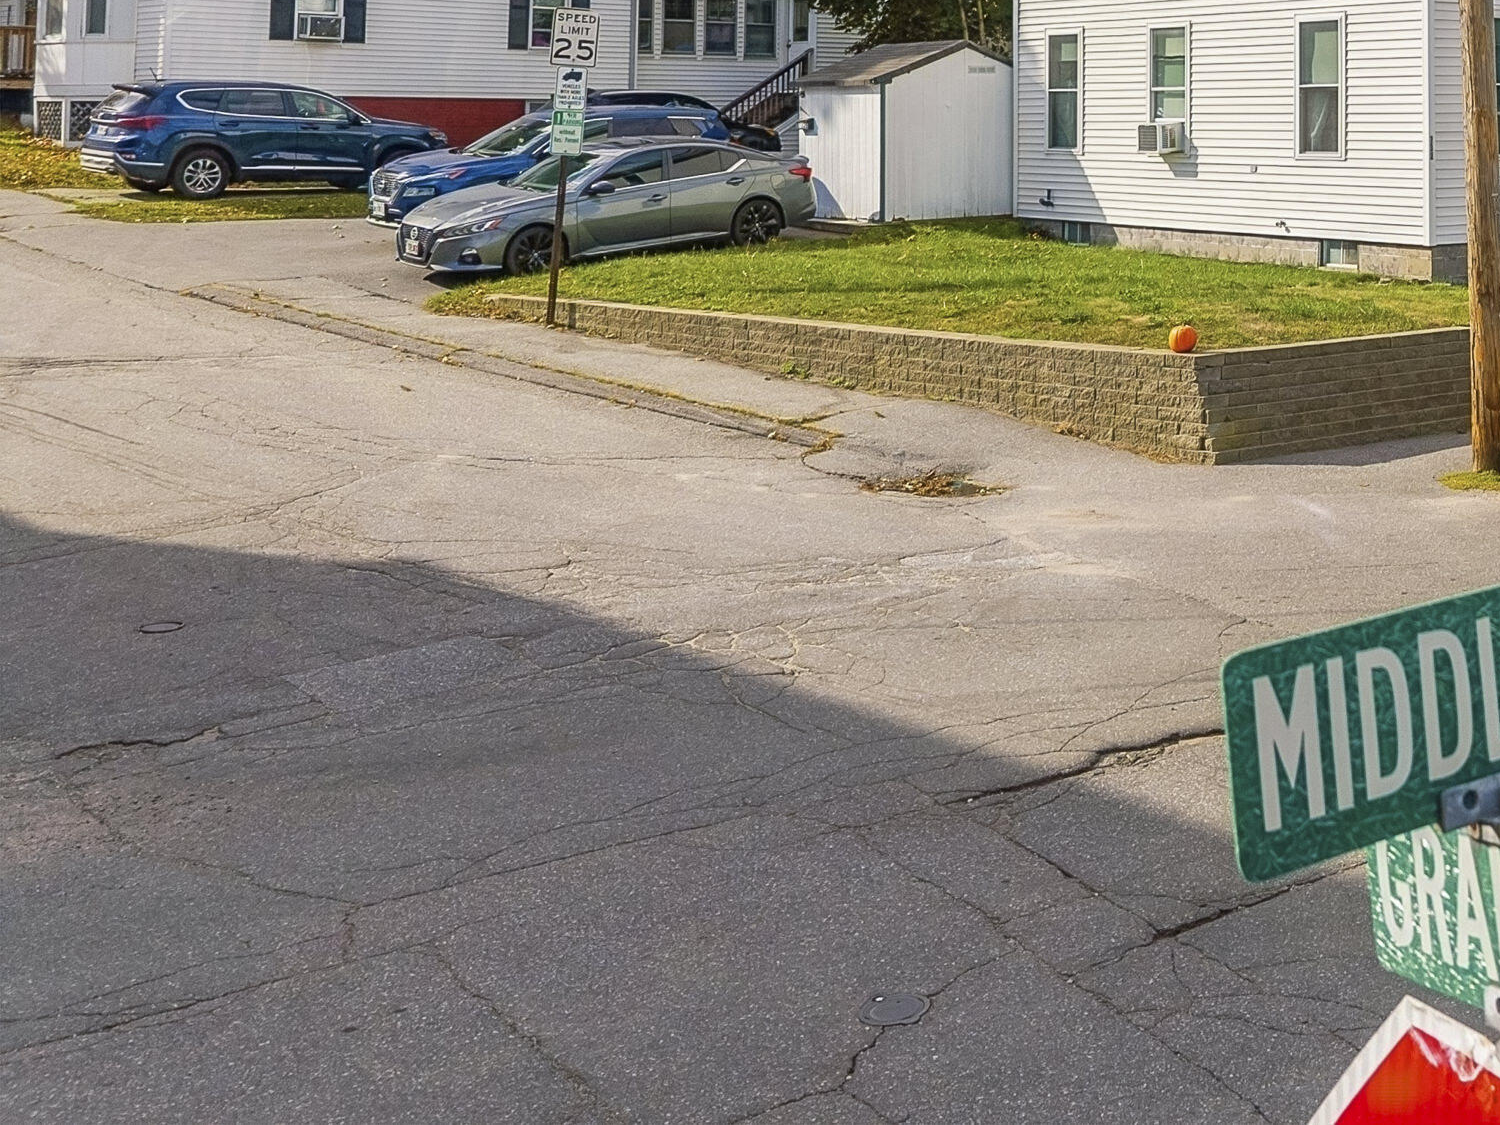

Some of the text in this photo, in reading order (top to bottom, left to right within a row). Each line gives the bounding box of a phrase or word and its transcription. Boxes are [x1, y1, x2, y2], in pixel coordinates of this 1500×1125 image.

[558, 13, 597, 24] SPEED
[560, 26, 591, 36] LIMIT
[554, 38, 594, 60] 25
